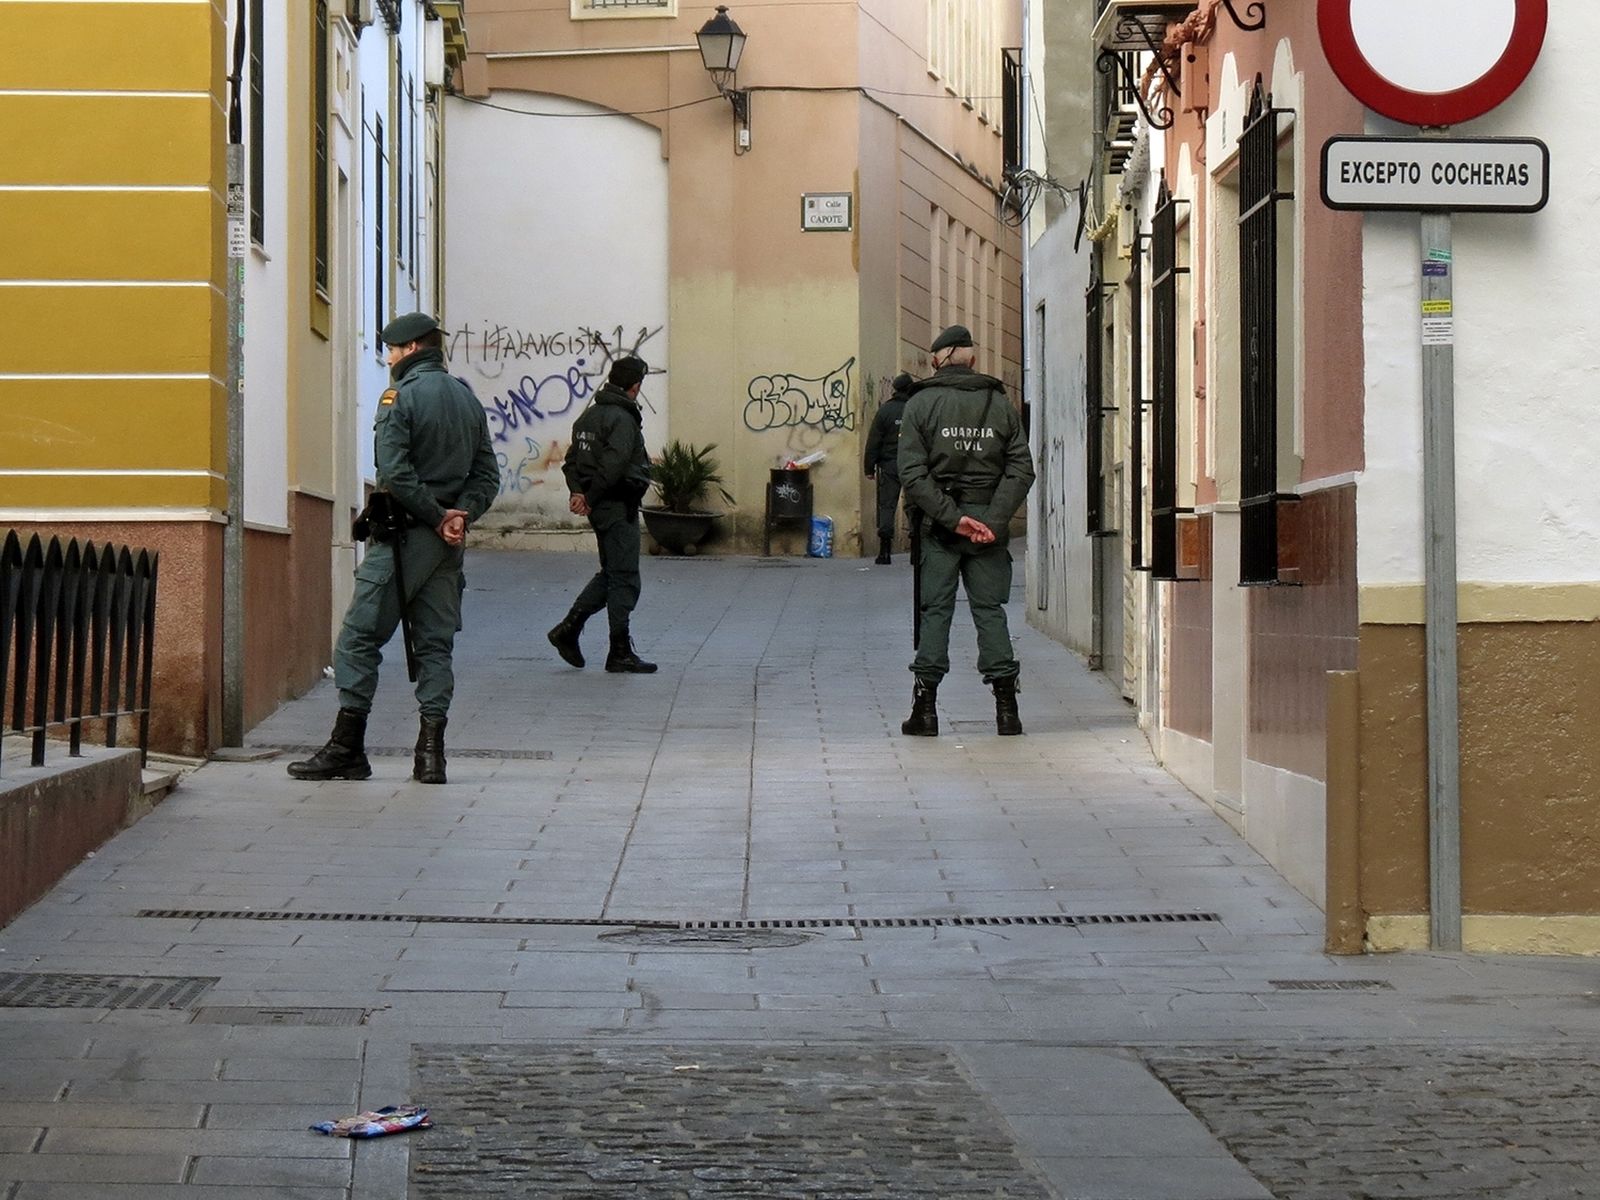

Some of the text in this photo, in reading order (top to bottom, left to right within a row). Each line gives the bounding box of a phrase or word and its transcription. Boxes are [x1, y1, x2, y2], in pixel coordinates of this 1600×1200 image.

[1340, 161, 1529, 186] EXCEPTO COCHERAS
[810, 215, 843, 223] CAPOTE
[941, 427, 994, 438] GUARDIA
[954, 440, 983, 451] CIVIL
